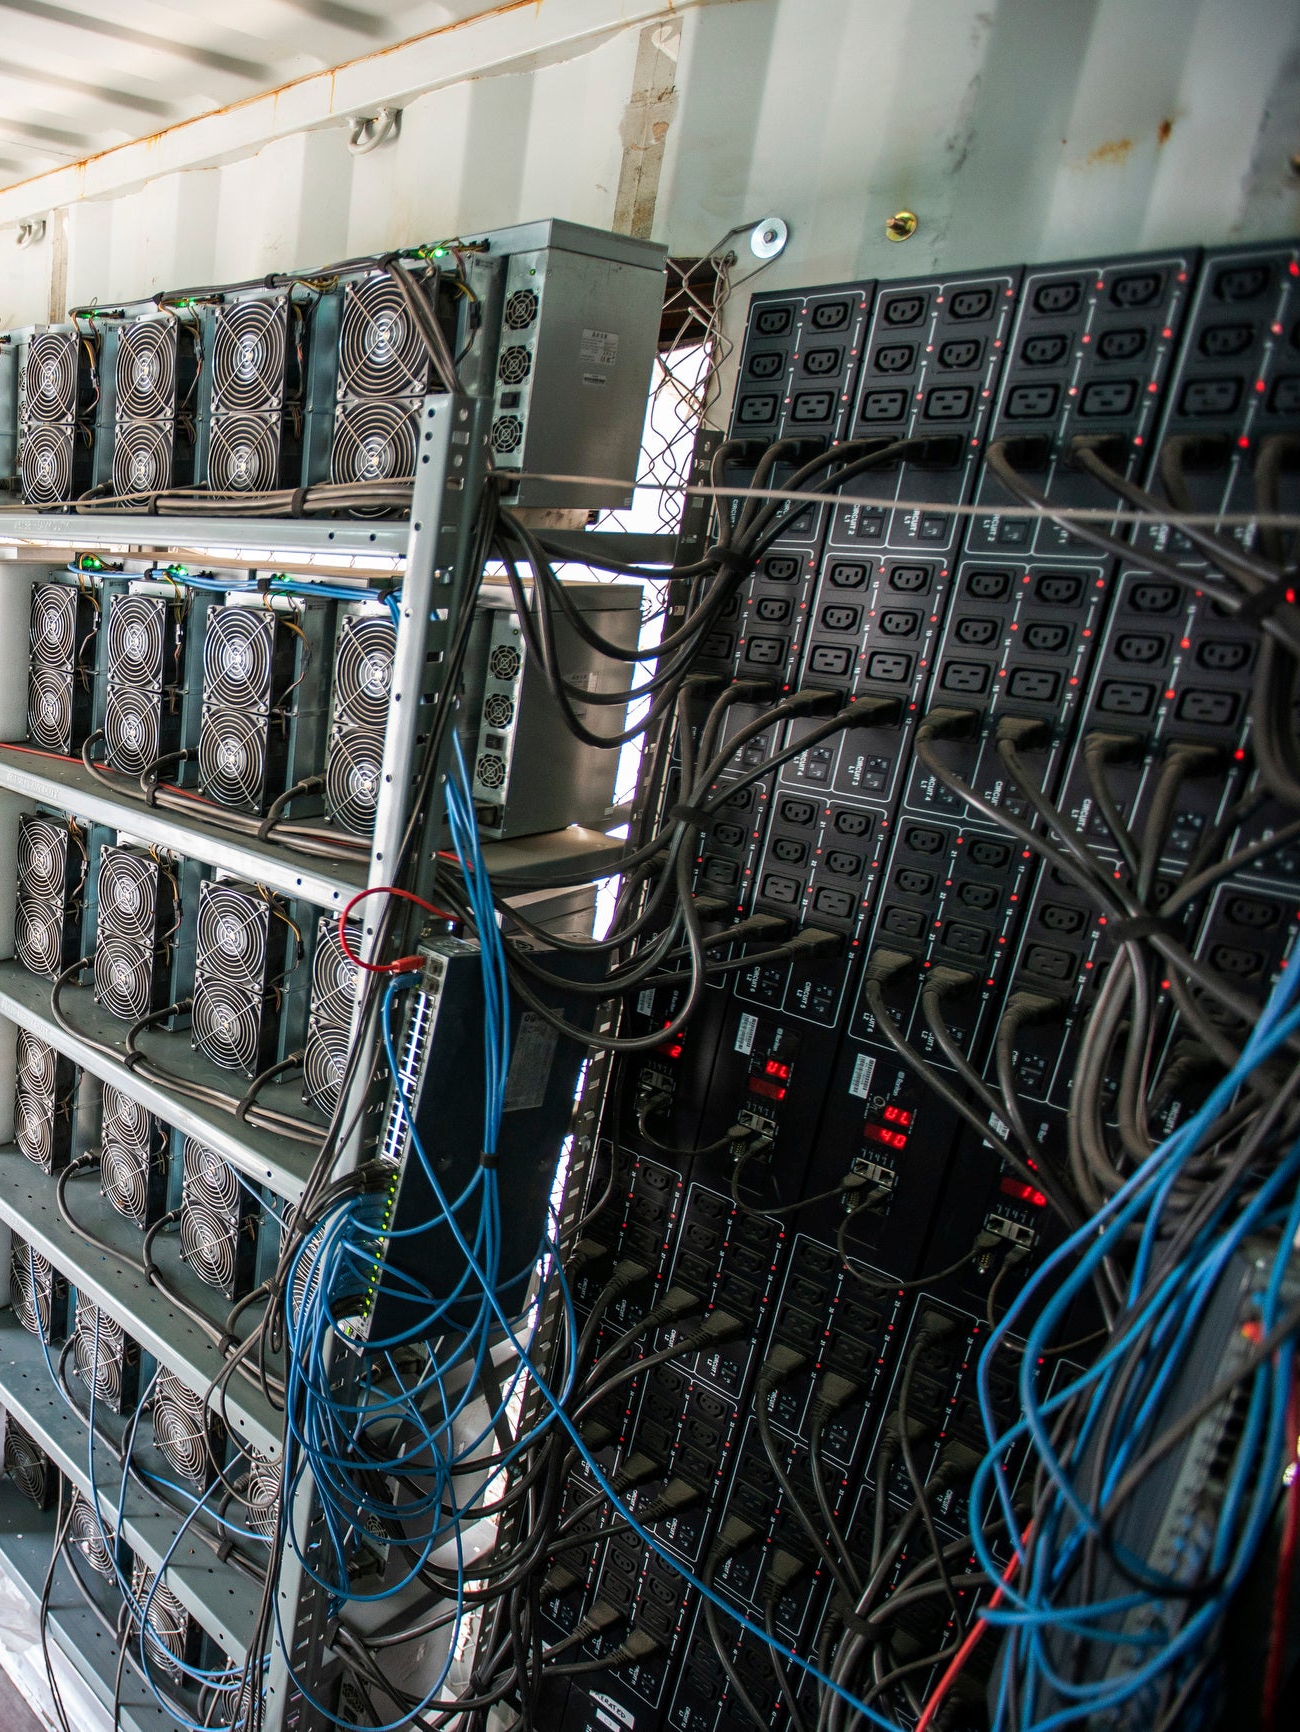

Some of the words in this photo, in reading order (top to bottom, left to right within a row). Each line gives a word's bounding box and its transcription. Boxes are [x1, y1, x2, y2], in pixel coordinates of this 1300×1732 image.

[853, 755, 865, 781] CIRCUIT
[750, 966, 761, 988] CIRCUIT
[801, 981, 812, 1005] CIRCUIT
[670, 1045, 682, 1058] 2
[881, 1128, 908, 1148] 40
